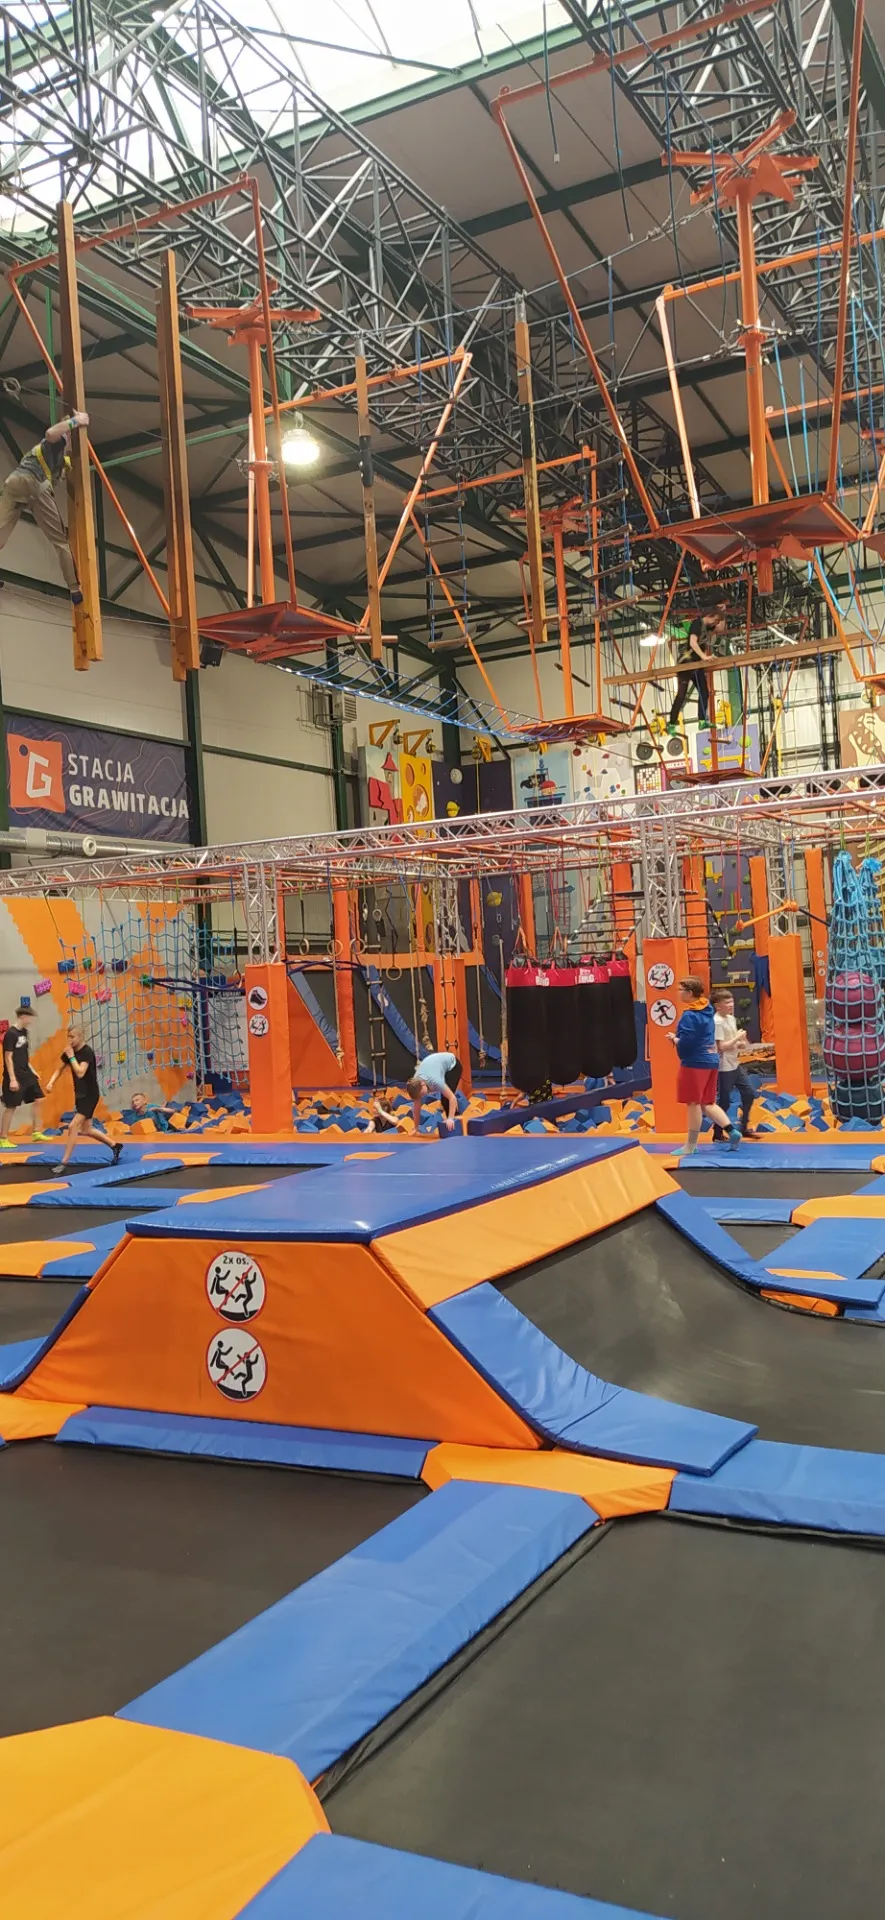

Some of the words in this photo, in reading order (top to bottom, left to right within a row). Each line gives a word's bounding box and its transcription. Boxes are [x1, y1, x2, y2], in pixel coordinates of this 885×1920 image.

[26, 752, 52, 799] G
[68, 753, 135, 784] STACJA
[69, 784, 189, 818] GRAWITACJA
[236, 1257, 249, 1265] os.
